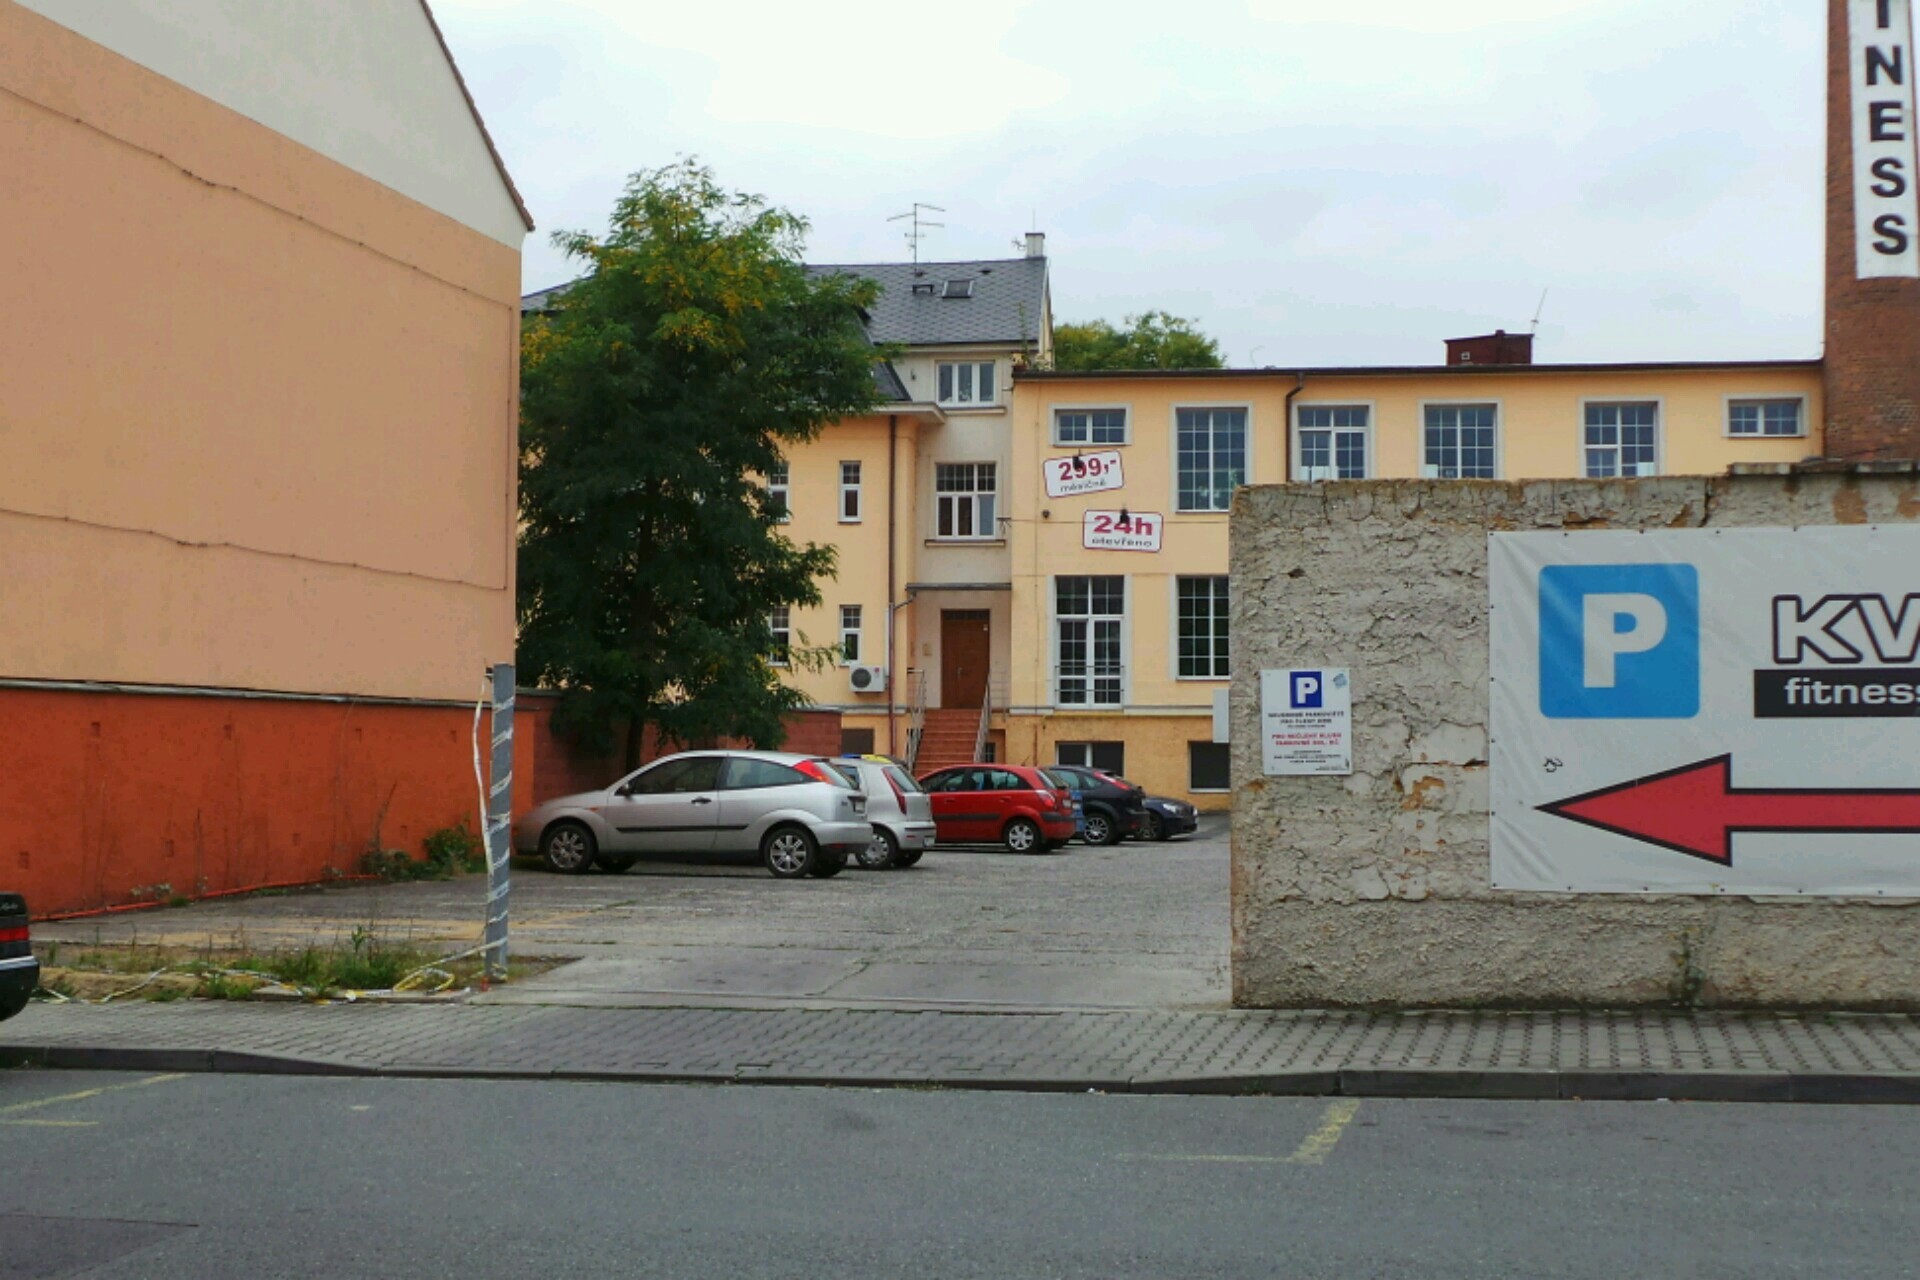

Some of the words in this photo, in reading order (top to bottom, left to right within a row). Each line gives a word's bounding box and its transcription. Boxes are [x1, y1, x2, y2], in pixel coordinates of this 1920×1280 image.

[1058, 458, 1117, 481] 299,-
[1093, 515, 1153, 535] 24h
[1092, 537, 1153, 547] otevřeno
[1582, 593, 1668, 688] P
[1296, 677, 1318, 704] P
[1785, 677, 1920, 705] fitnes
